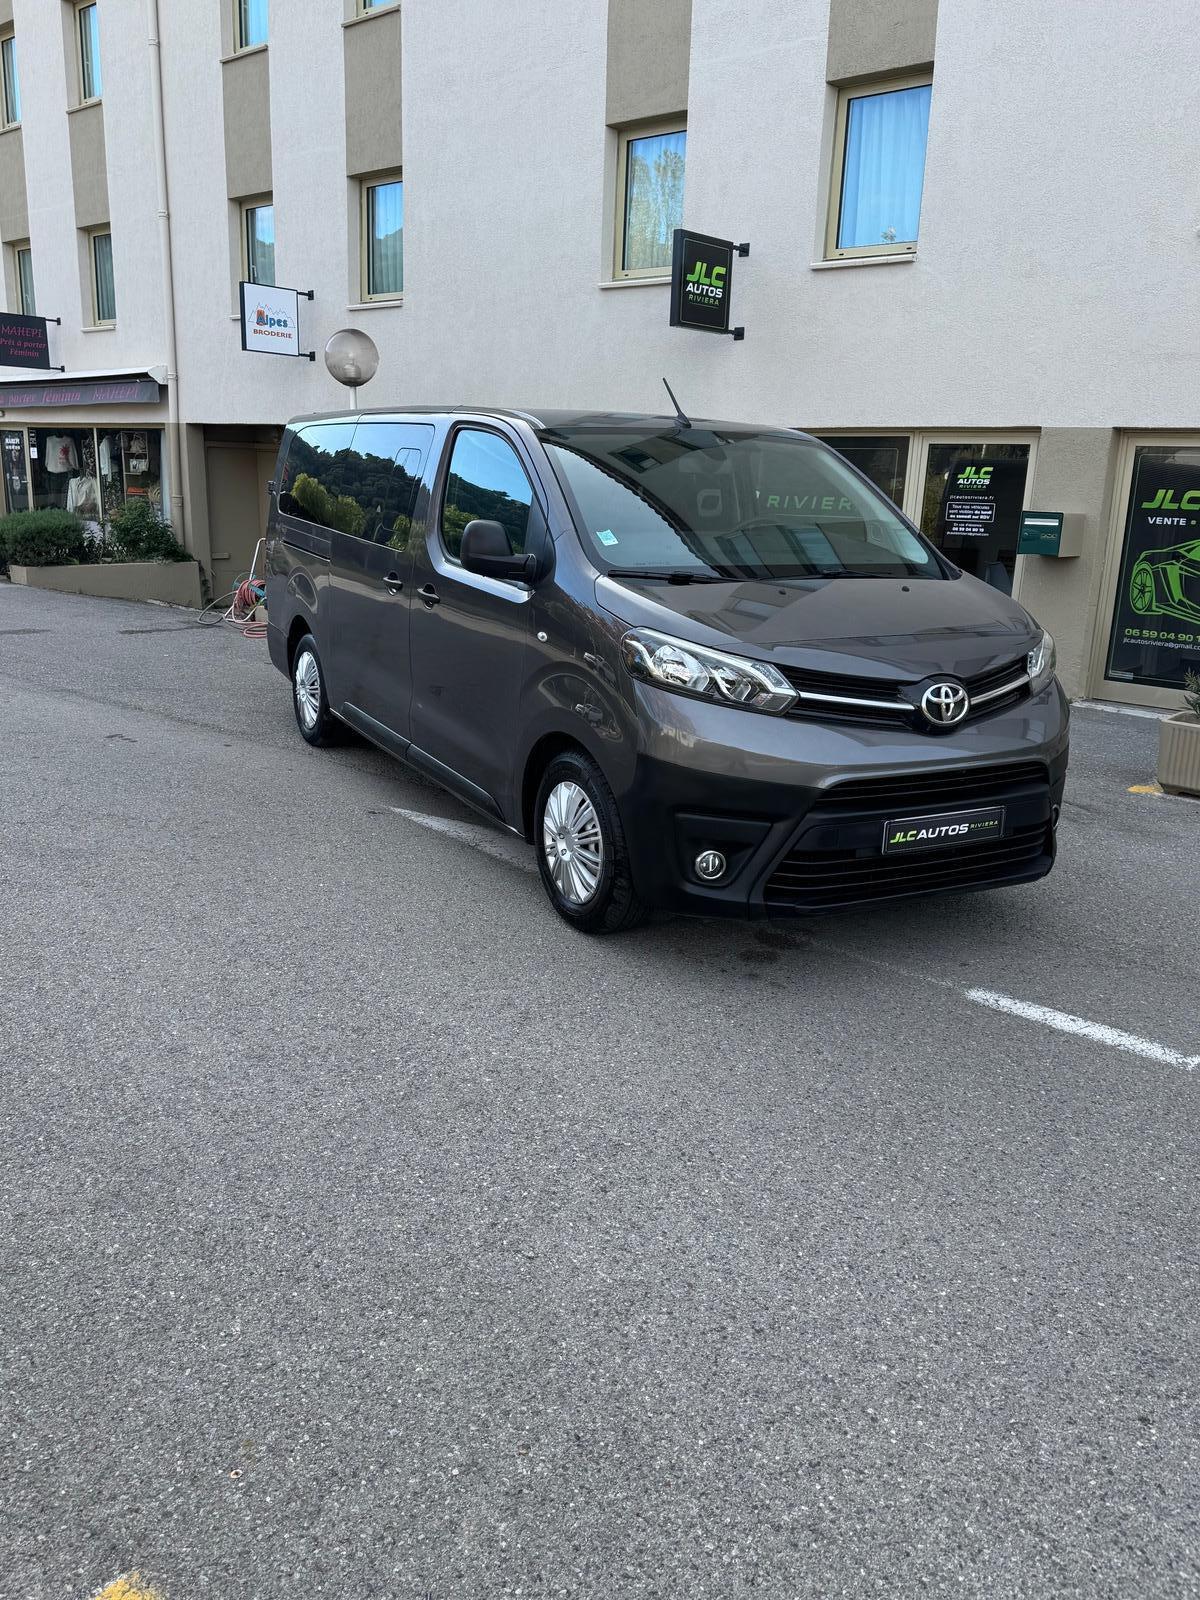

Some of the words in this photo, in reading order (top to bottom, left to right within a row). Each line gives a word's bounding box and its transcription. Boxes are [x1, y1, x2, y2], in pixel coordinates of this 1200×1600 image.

[686, 261, 727, 288] JLC
[686, 282, 723, 298] AUTOS
[688, 294, 720, 306] RIVIERA
[256, 312, 288, 328] Alpes
[254, 328, 292, 338] BRODERIE
[957, 466, 994, 479] JLC
[766, 495, 856, 511] RIVIER
[1141, 489, 1200, 510] JLC
[1147, 516, 1187, 526] VENTE
[1125, 628, 1140, 636] 06
[1142, 630, 1158, 639] 59
[1160, 631, 1176, 640] 04
[1178, 633, 1194, 642] 90
[1124, 637, 1200, 650] jlcautosriviera@gmail.co
[970, 820, 998, 829] RIVIERA
